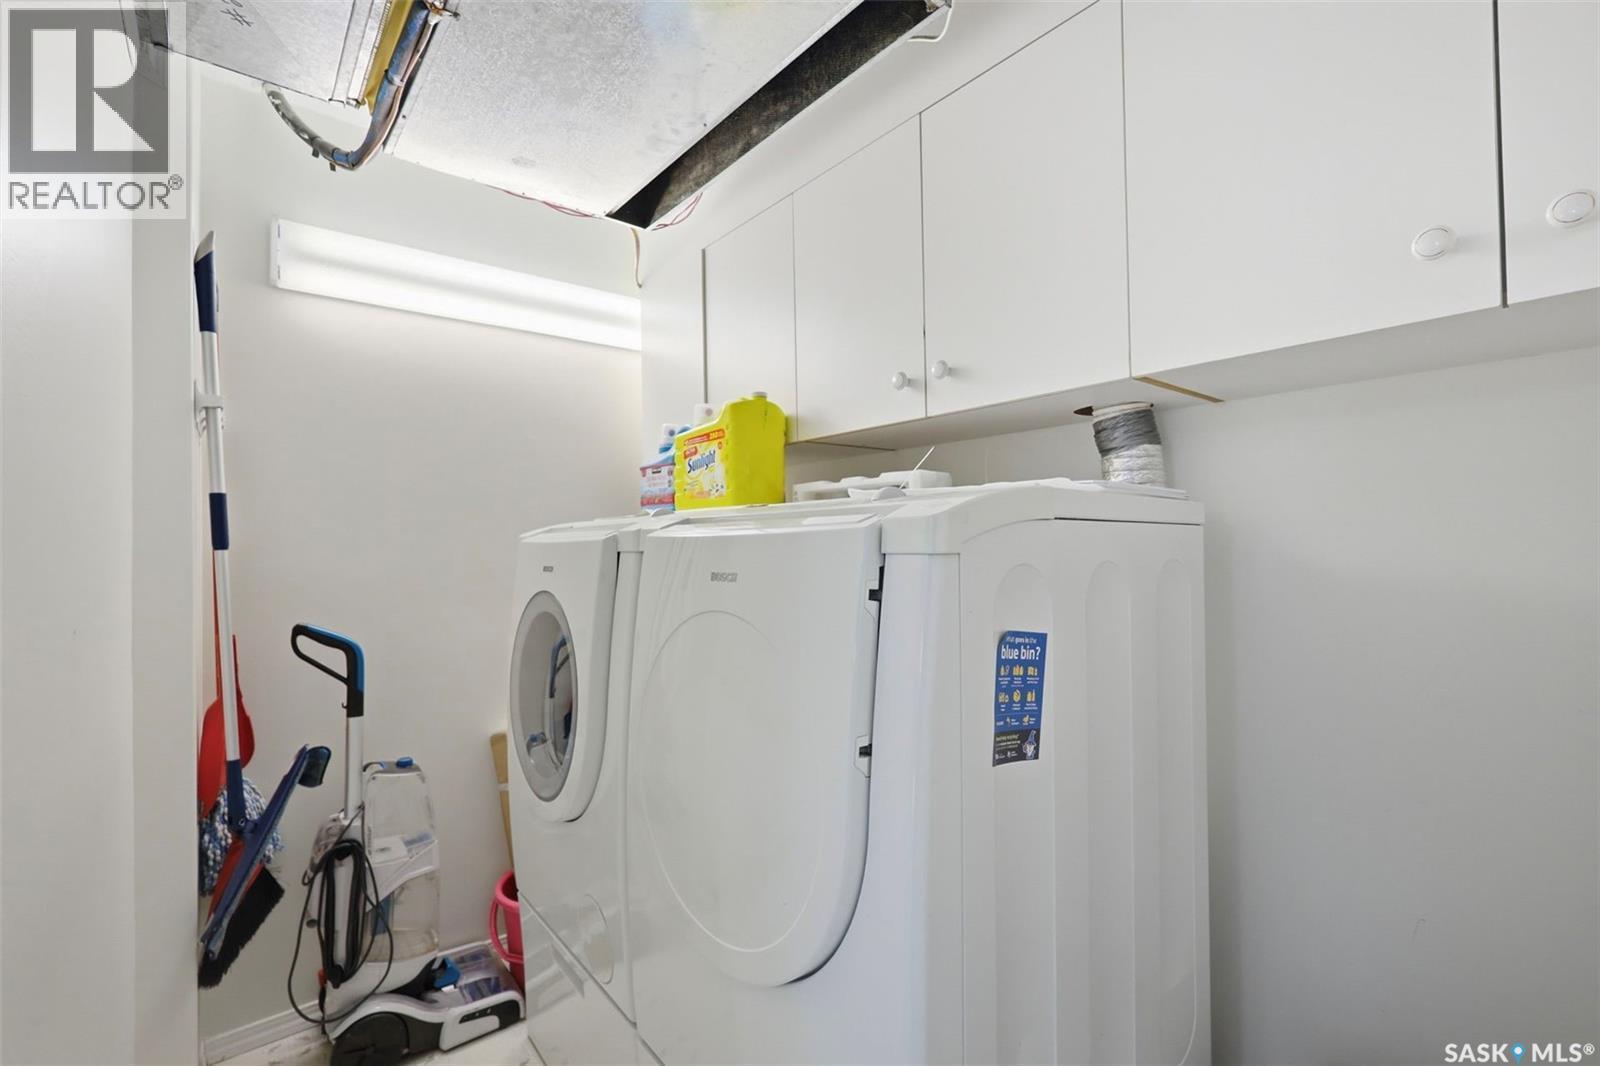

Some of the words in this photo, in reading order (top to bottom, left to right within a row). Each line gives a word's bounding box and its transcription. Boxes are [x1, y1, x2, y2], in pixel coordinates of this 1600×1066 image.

[687, 449, 716, 474] Sunlight
[1001, 644, 1019, 660] blue
[1020, 645, 1041, 660] bin?
